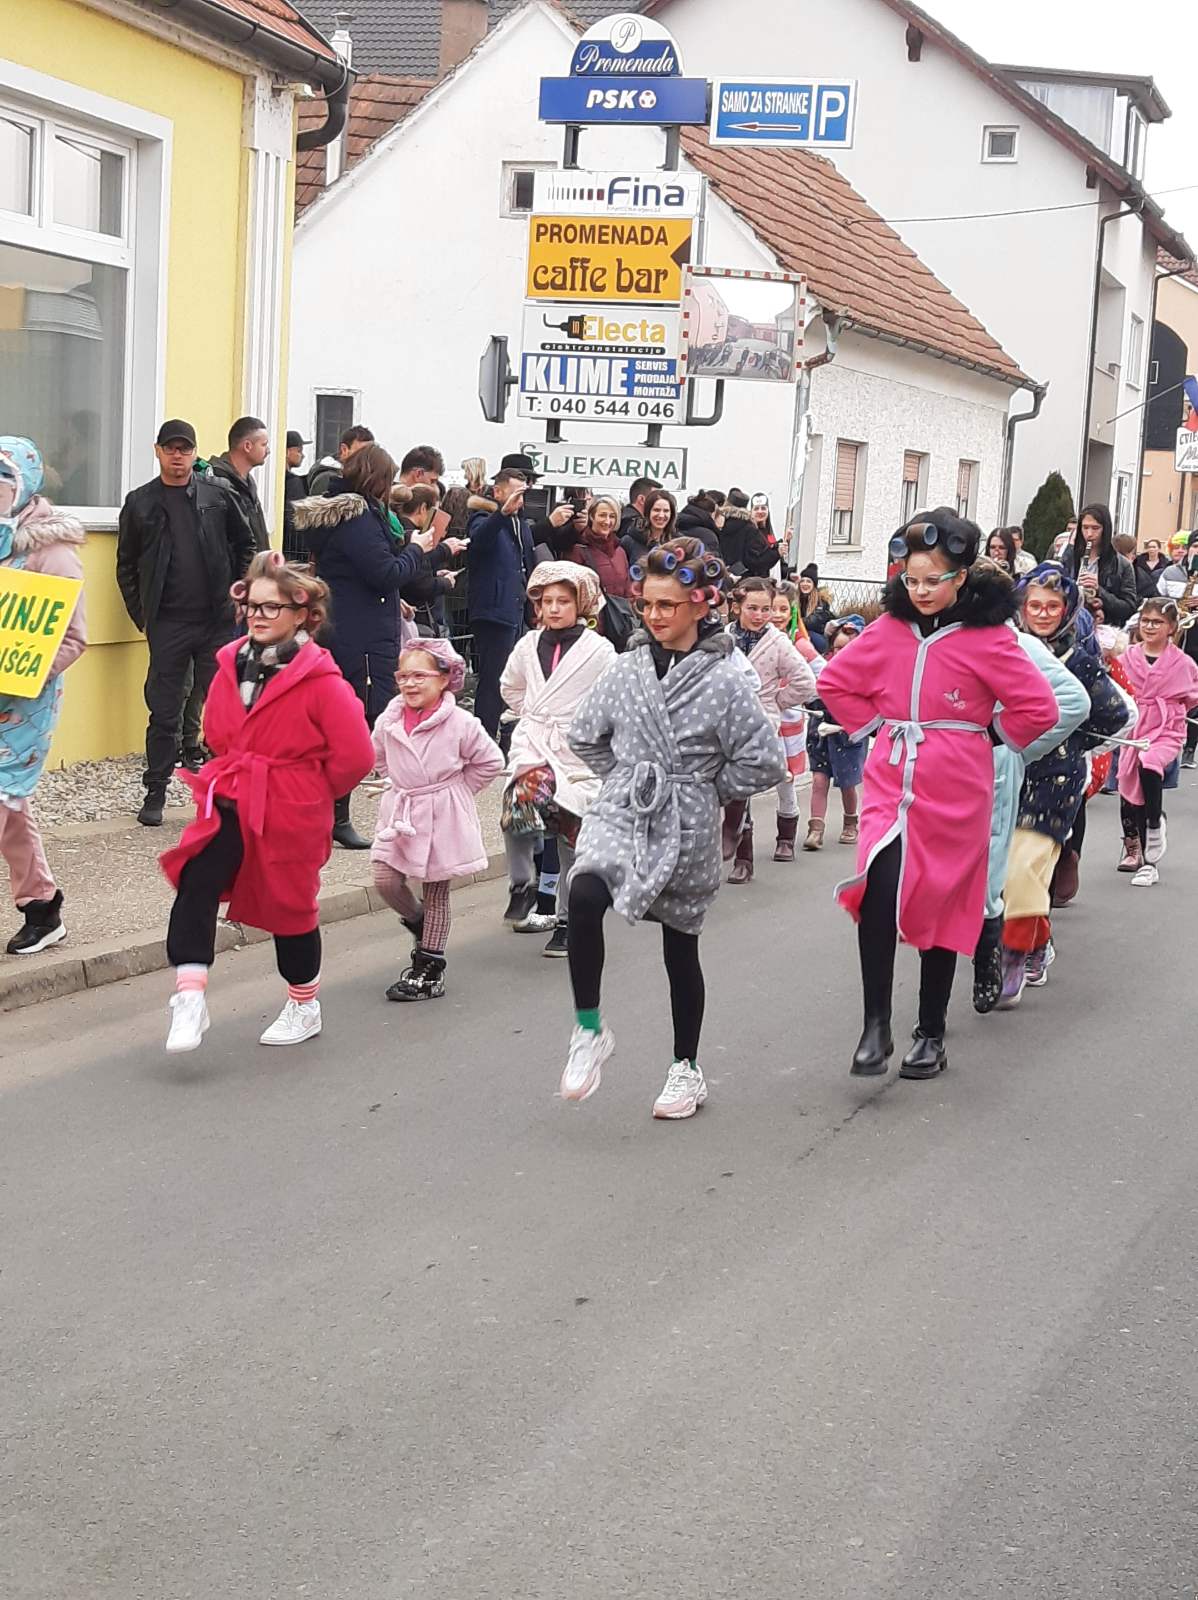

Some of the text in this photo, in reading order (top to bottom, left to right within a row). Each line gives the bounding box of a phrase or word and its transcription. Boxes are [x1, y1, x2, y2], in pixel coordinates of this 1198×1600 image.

[575, 44, 674, 73] Promenada
[586, 89, 638, 109] PSK
[721, 90, 809, 115] SAMO ZA STRANKE
[818, 90, 846, 136] P
[607, 176, 685, 207] Fina
[535, 223, 669, 246] PROMENADA
[533, 256, 669, 294] caffe bar
[583, 316, 666, 343] Electa
[525, 355, 629, 396] KLIME
[635, 360, 668, 372] SERVIS
[633, 385, 677, 398] MONTAŽA
[634, 373, 677, 385] PRODAJA
[525, 396, 675, 418] T: 040 544 046
[543, 455, 680, 480] LJEKARNA
[0, 641, 43, 678] IŠĆA
